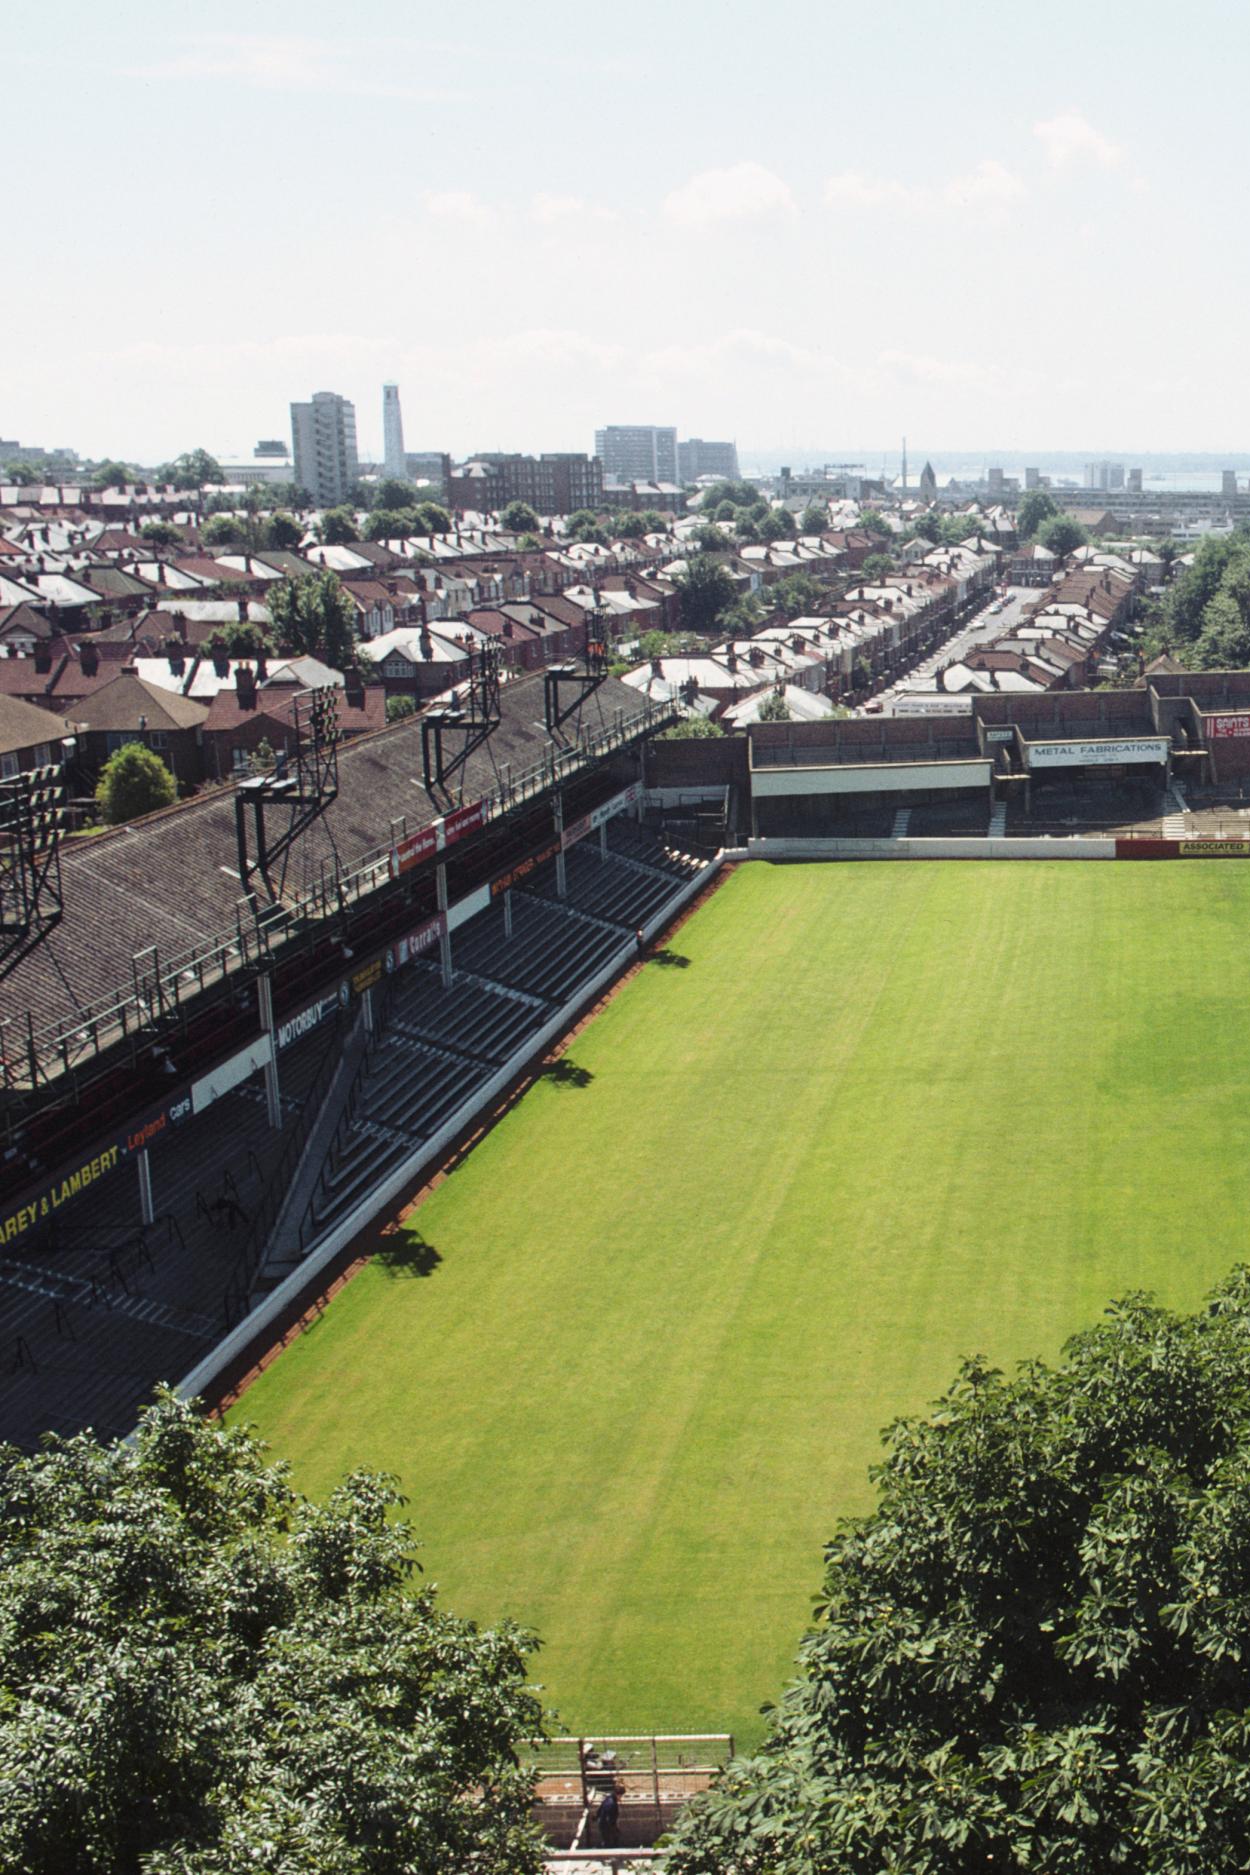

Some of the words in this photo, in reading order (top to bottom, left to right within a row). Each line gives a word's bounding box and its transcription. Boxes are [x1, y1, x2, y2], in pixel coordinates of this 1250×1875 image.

[1216, 717, 1249, 729] SAINTS
[1034, 747, 1075, 756] METAL
[1080, 743, 1162, 754] FABRICATIONS
[278, 1000, 324, 1048] MOTORBUY
[127, 1112, 166, 1150] Leyland
[41, 1196, 49, 1216] &
[51, 1145, 118, 1208] LAMBERT
